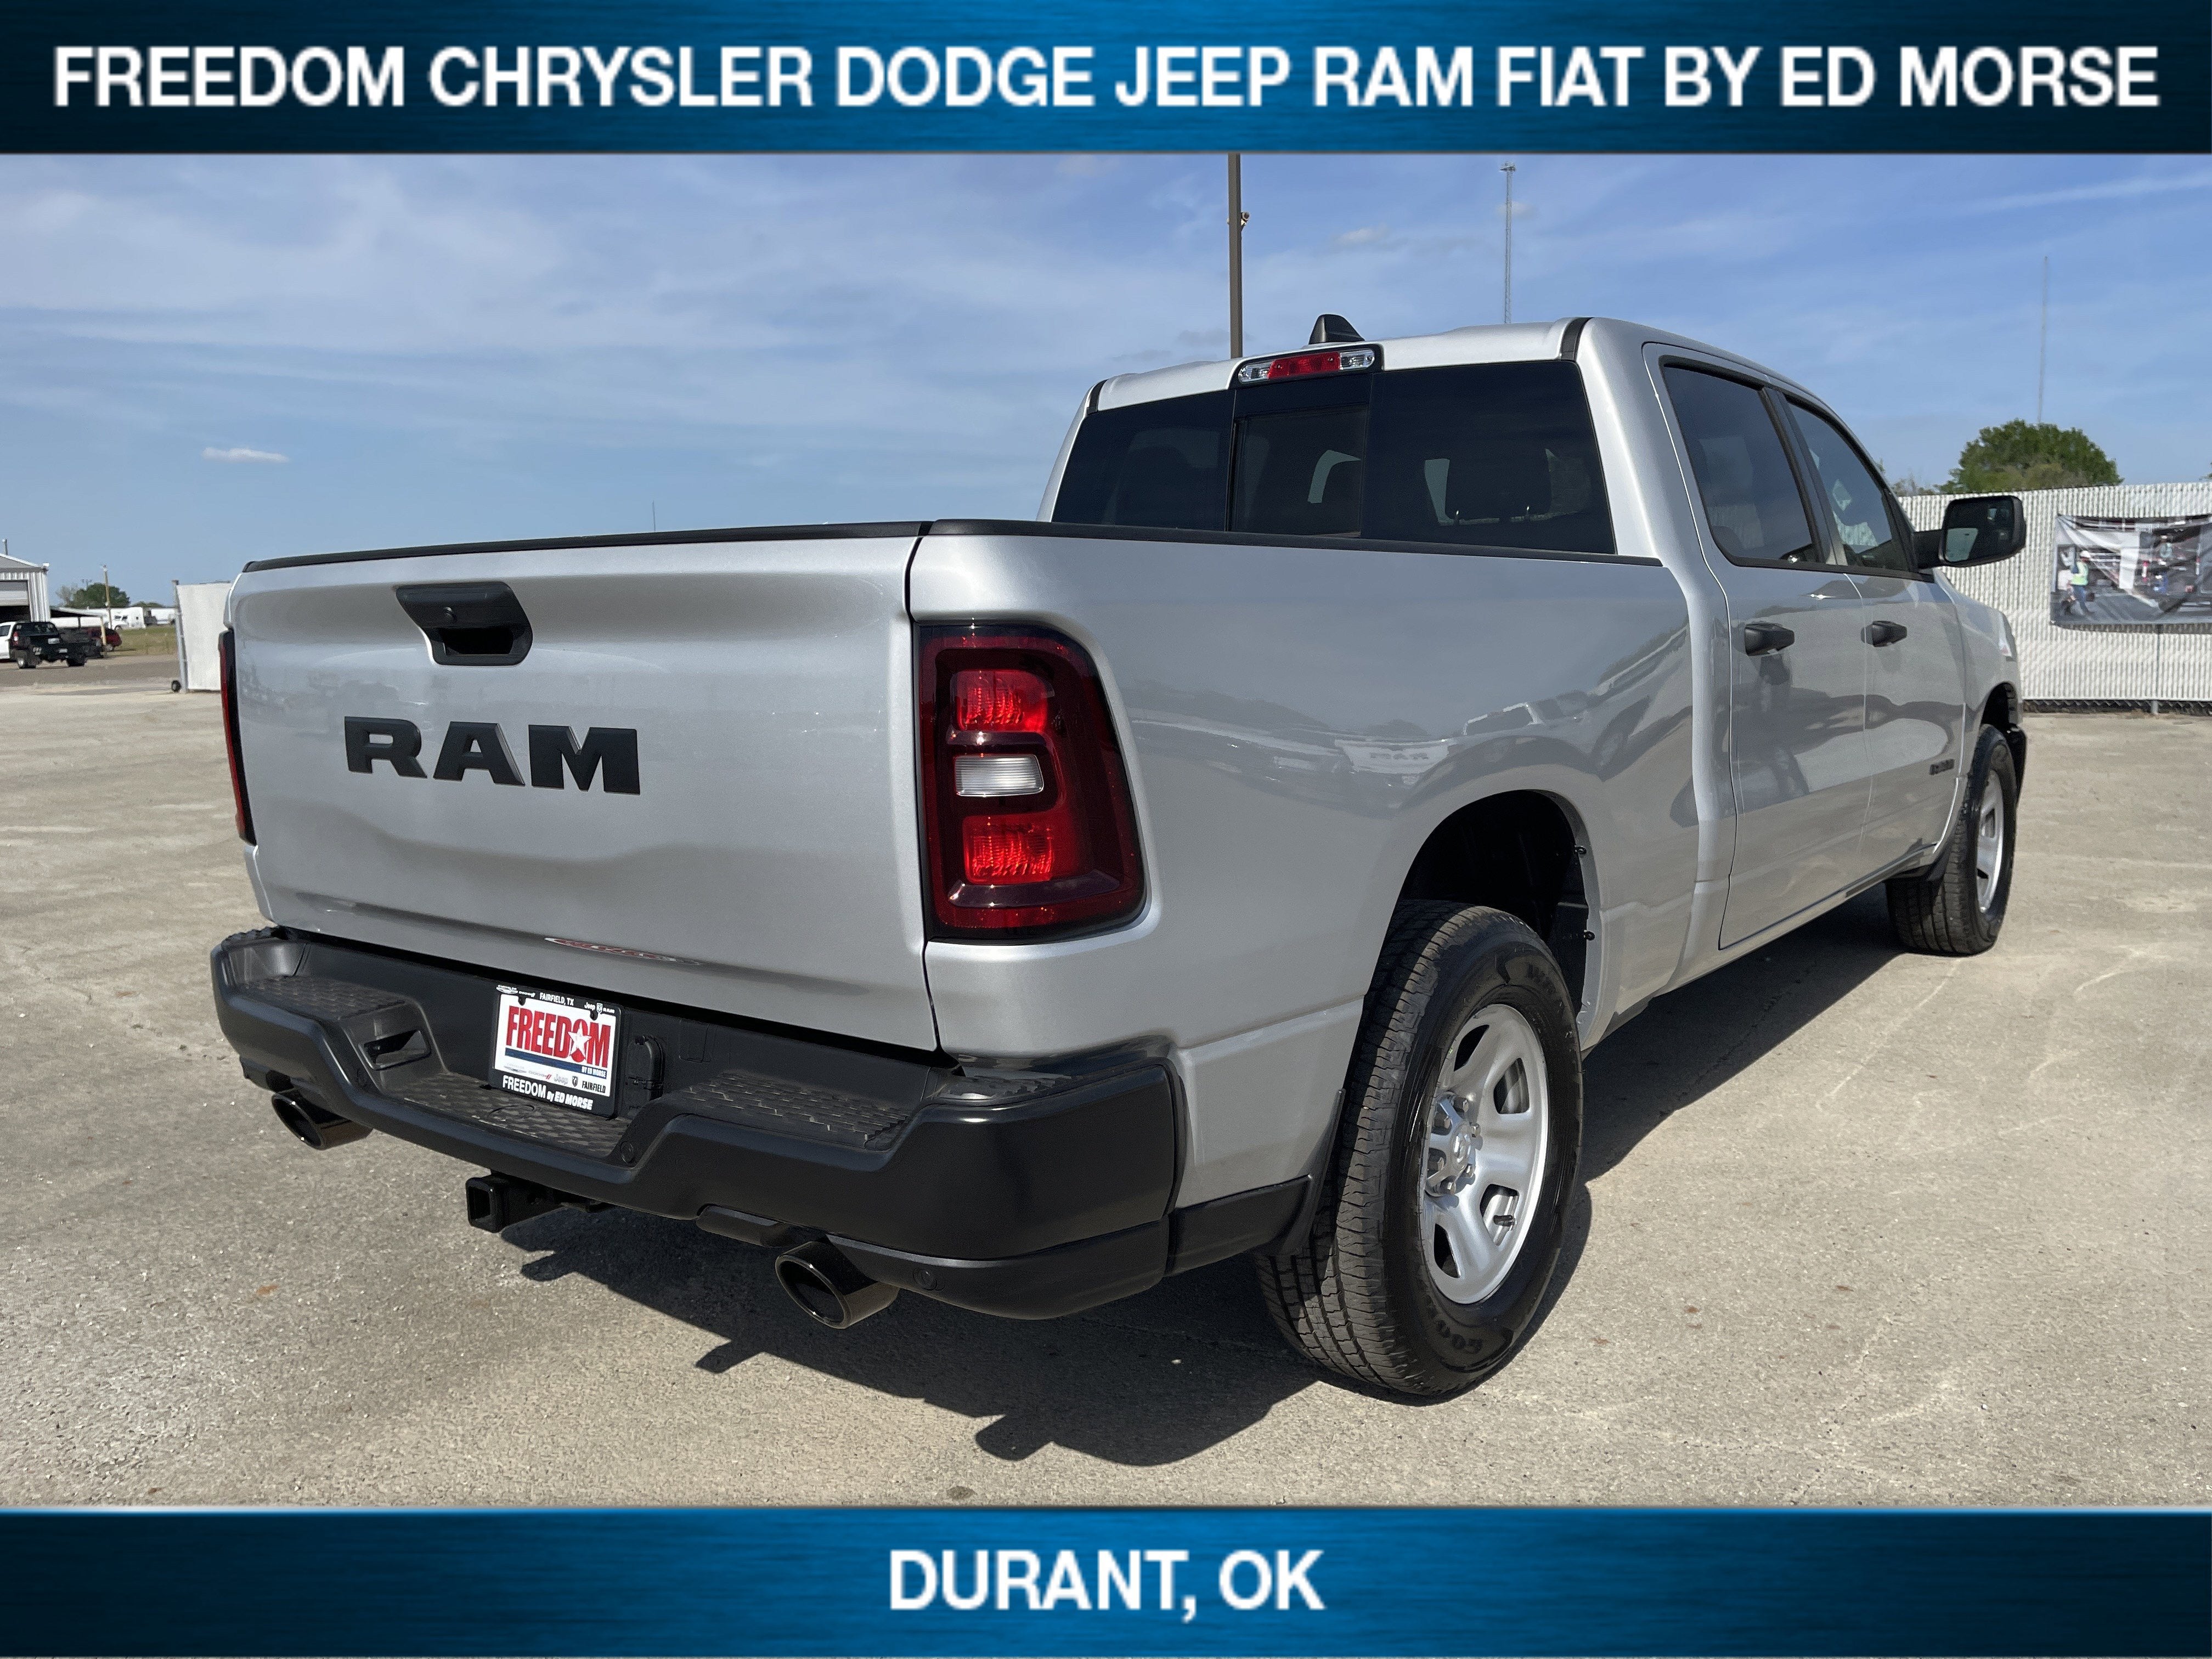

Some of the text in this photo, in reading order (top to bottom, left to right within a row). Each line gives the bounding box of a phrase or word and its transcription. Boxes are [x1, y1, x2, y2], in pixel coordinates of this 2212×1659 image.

[344, 716, 640, 795] RAM
[539, 992, 574, 1006] FAIRFIELD, TX
[584, 1002, 596, 1011] Jeep
[506, 1005, 611, 1068] FREEDOM
[503, 1074, 546, 1098] FREEDOM
[554, 1091, 565, 1103] ED
[565, 1093, 594, 1110] MORSE
[582, 1080, 606, 1093] FAIRFIELD
